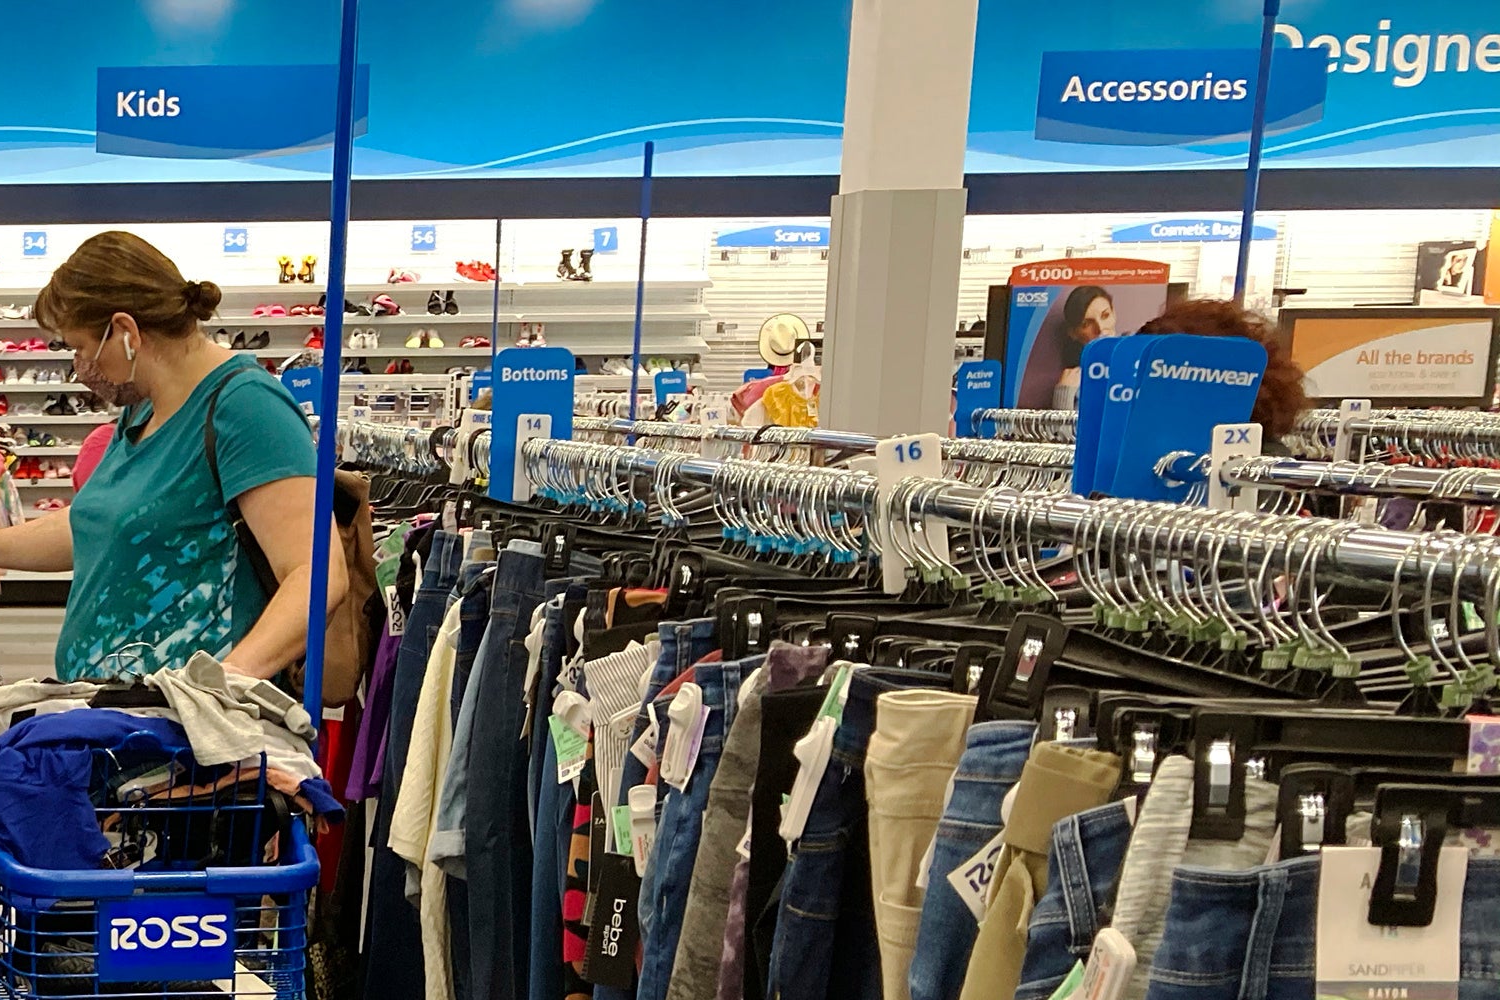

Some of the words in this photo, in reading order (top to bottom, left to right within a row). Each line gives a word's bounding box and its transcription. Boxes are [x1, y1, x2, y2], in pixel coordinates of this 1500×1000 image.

[1061, 73, 1248, 104] Accessories
[117, 89, 181, 118] Kids
[413, 231, 434, 244] 5-6
[774, 229, 821, 242] Scarves
[1151, 223, 1207, 238] Cosmetic
[24, 236, 45, 249] 3-4
[225, 233, 246, 247] 5-6
[601, 232, 610, 247] 7
[1020, 268, 1073, 282] $1,000
[1016, 292, 1049, 302] ROSS
[1356, 350, 1380, 365] All
[1384, 350, 1413, 365] the
[1416, 349, 1474, 365] brands
[502, 366, 568, 384] Bottoms
[966, 369, 994, 380] Active
[1149, 358, 1259, 387] Swimwear
[292, 377, 311, 388] Tops
[967, 380, 992, 390] Pants
[353, 409, 366, 418] 3X
[1350, 402, 1362, 411] M
[706, 410, 719, 421] 1X
[527, 417, 541, 430] 14
[1224, 428, 1250, 445] 2X
[894, 442, 923, 463] 16
[390, 592, 403, 632] ROSS
[594, 817, 607, 826] ZA
[110, 914, 227, 951] ROSS
[608, 898, 627, 957] bebe
[601, 925, 610, 955] sport
[1368, 987, 1409, 999] RAYON
